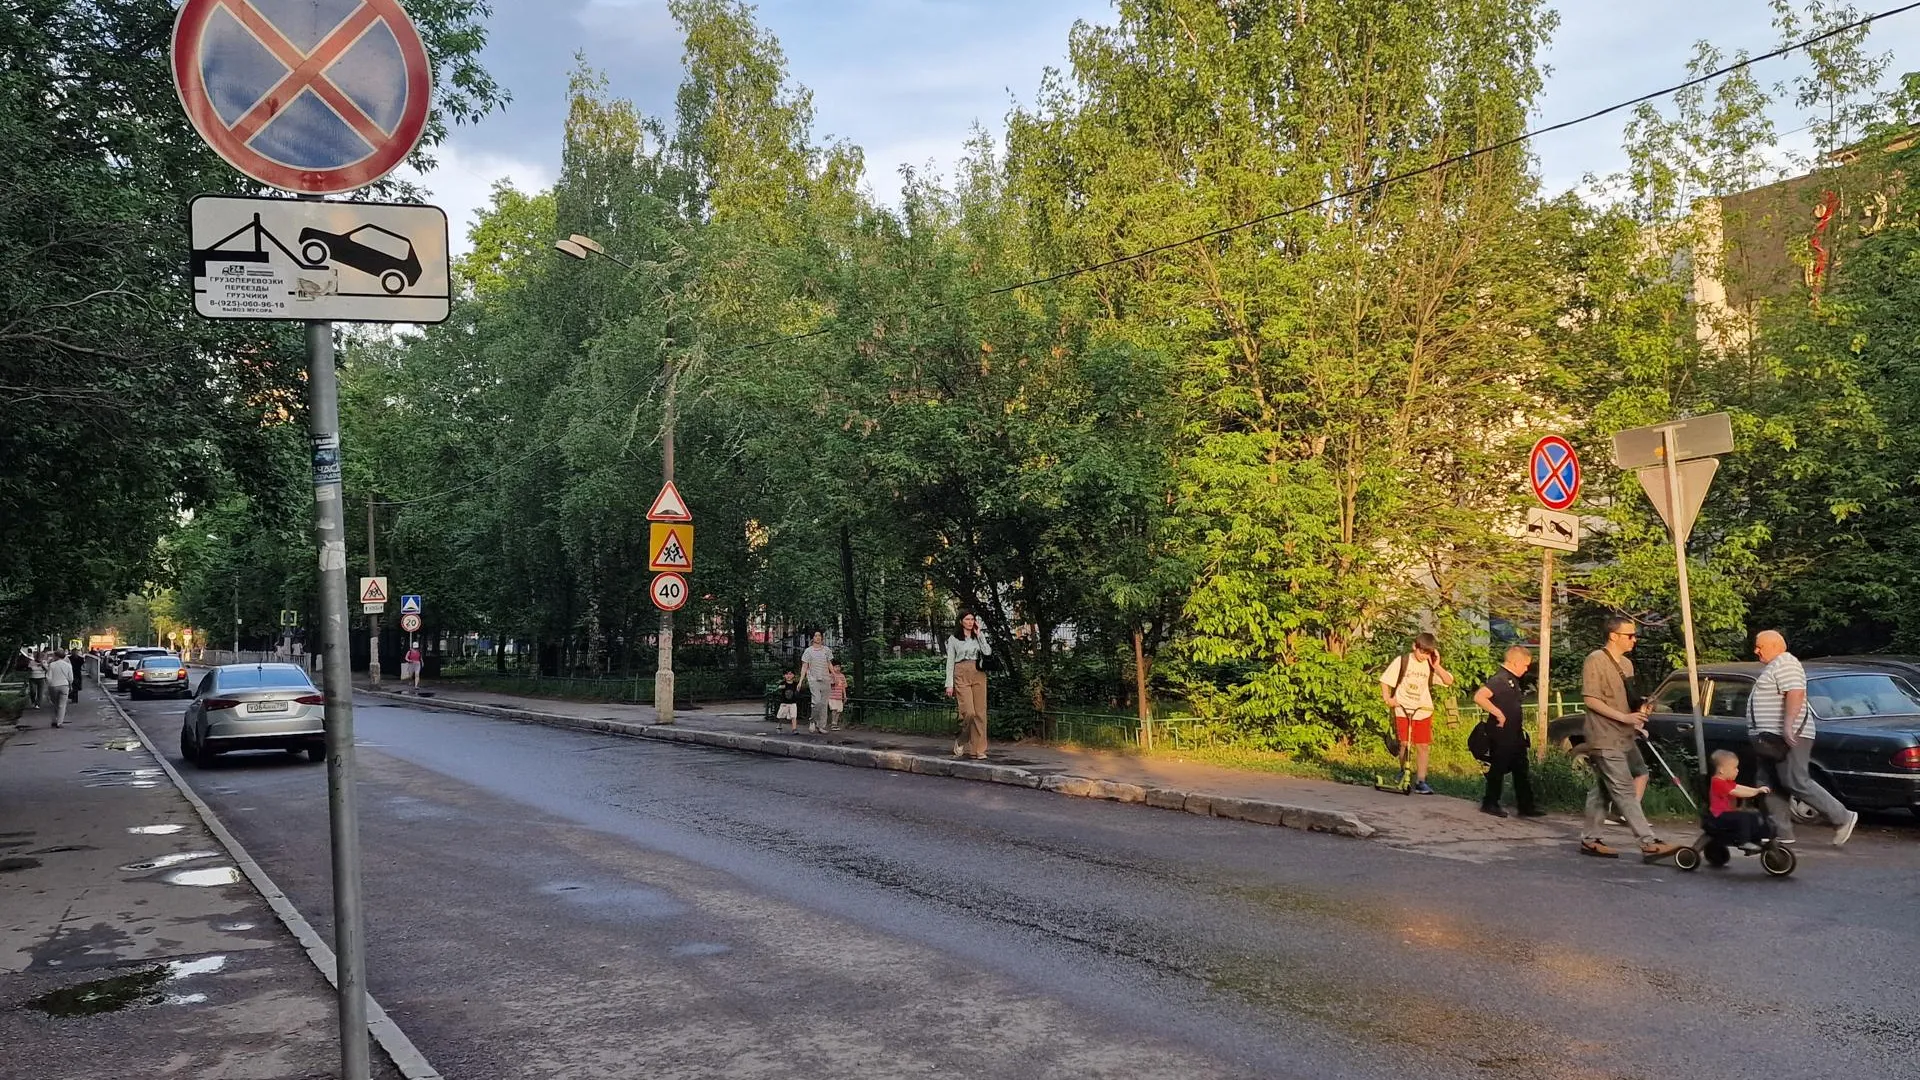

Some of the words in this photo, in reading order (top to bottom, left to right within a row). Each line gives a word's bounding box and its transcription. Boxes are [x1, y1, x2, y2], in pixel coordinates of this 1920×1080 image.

[209, 276, 284, 285] ГРУЗОПЕРЕВОЗКИ
[659, 583, 680, 598] 40
[406, 619, 417, 628] 20
